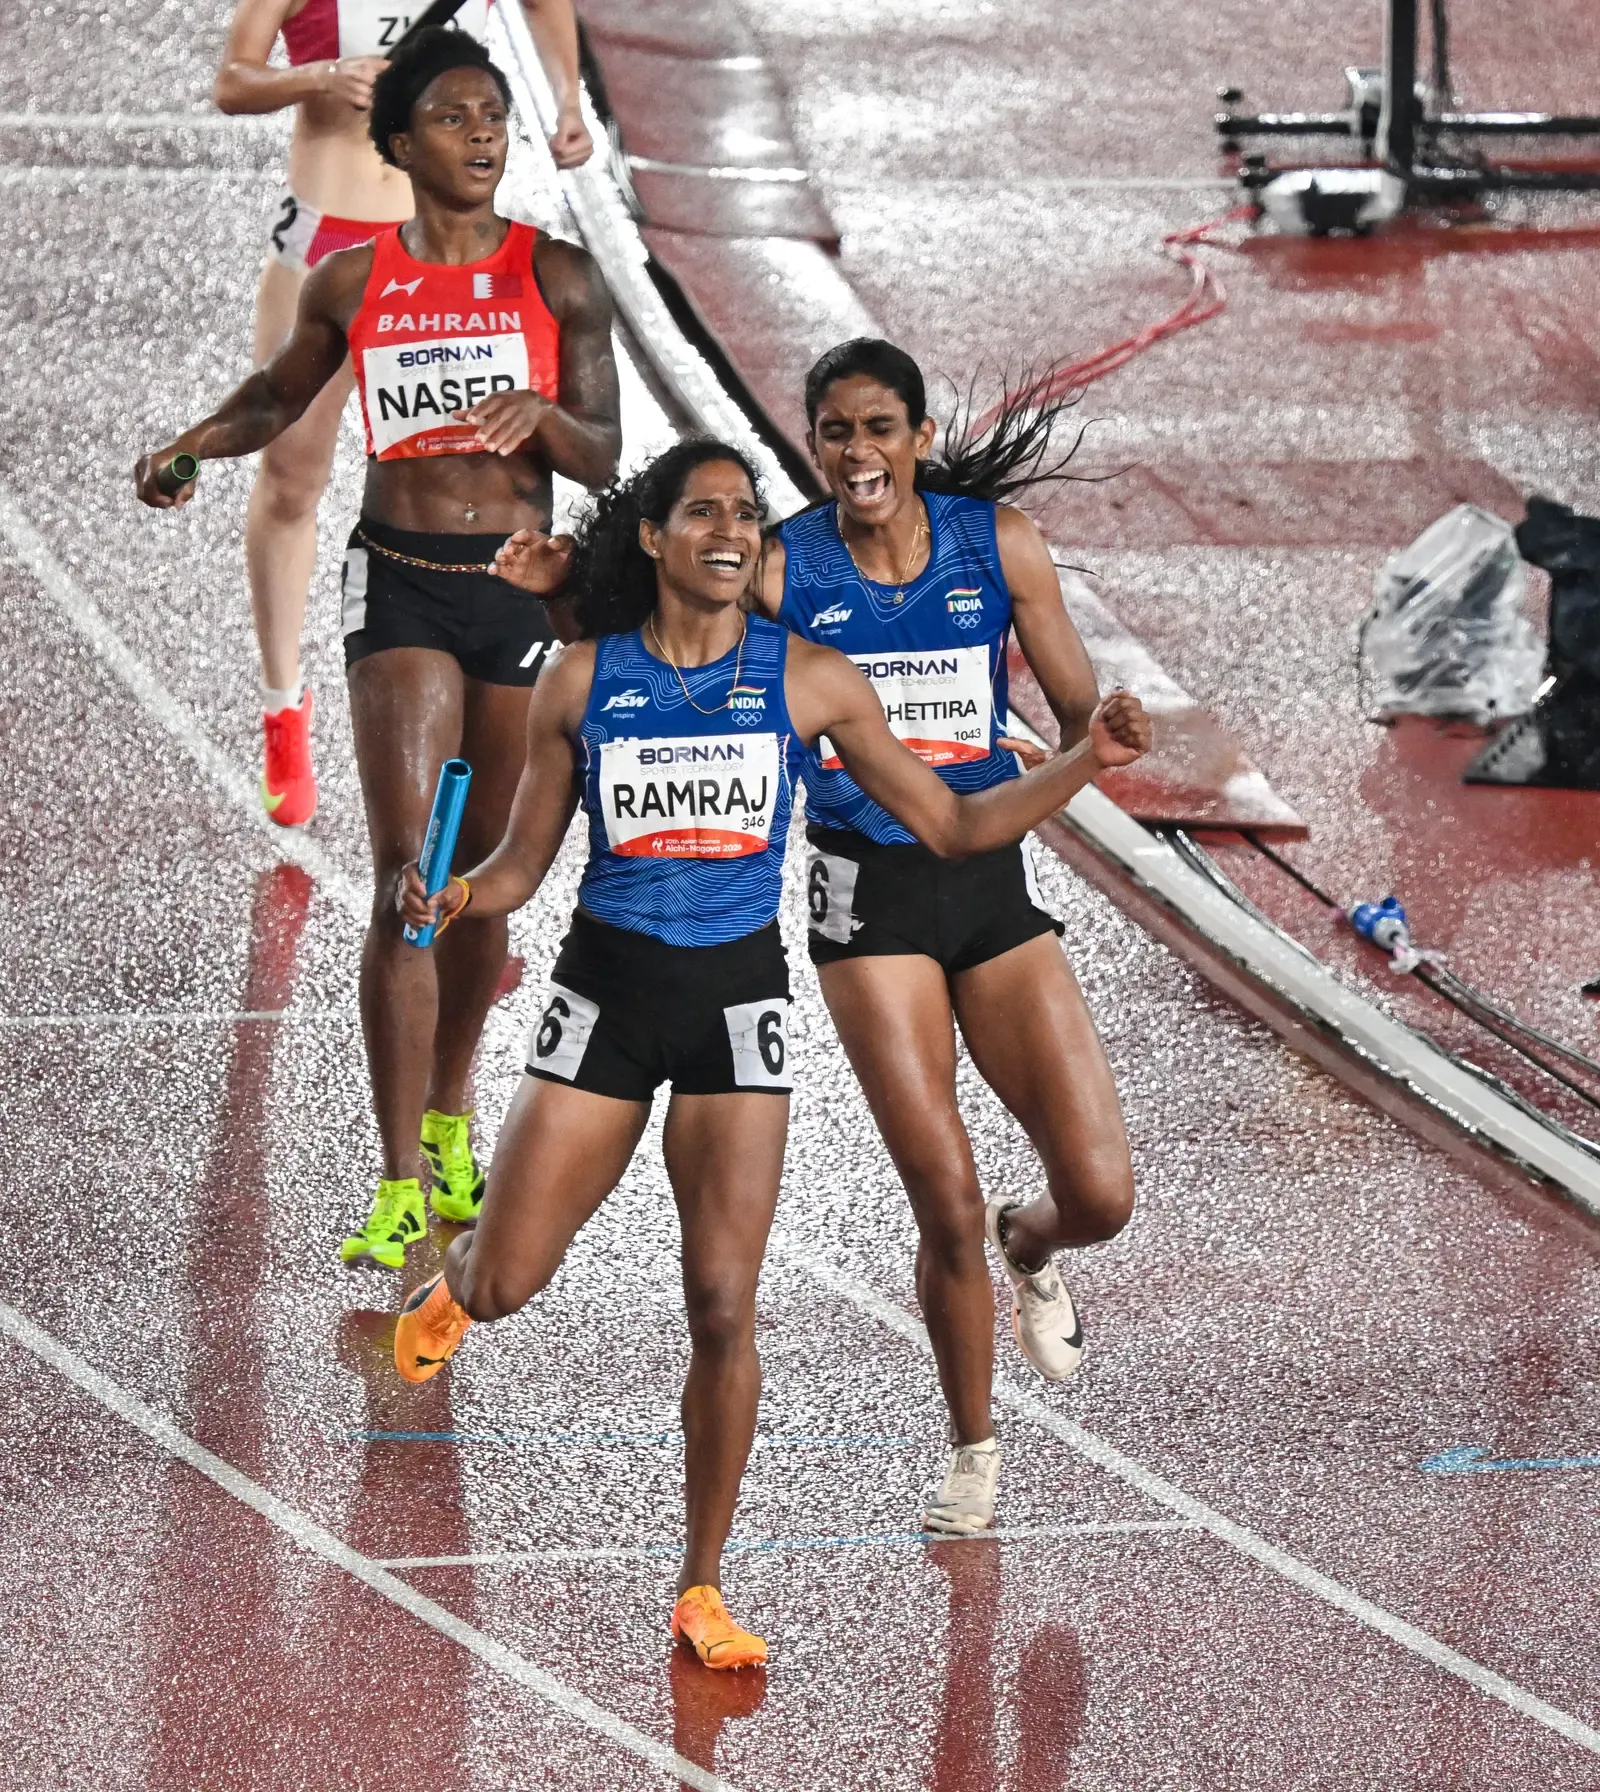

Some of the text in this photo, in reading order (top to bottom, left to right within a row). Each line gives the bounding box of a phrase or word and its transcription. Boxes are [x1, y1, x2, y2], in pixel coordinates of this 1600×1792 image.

[271, 196, 297, 252] 2
[377, 311, 521, 333] BAHRAIN
[397, 344, 493, 367] BORNAN
[947, 597, 984, 613] INDIA
[808, 608, 853, 628] JSW
[600, 695, 650, 712] JSW
[728, 697, 767, 710] INDIA
[887, 699, 978, 723] HETTIRA
[954, 728, 982, 741] 1043
[636, 743, 745, 765] BORNAN
[934, 752, 955, 761] 2026
[640, 762, 744, 776] SPORTS TECHNOLOGY
[613, 775, 768, 819] RAMRAJ
[741, 816, 766, 831] 346
[665, 843, 743, 854] Aichi-Nagoya 2026
[807, 859, 830, 924] 6
[536, 995, 571, 1059] 6
[757, 1010, 785, 1076] 6
